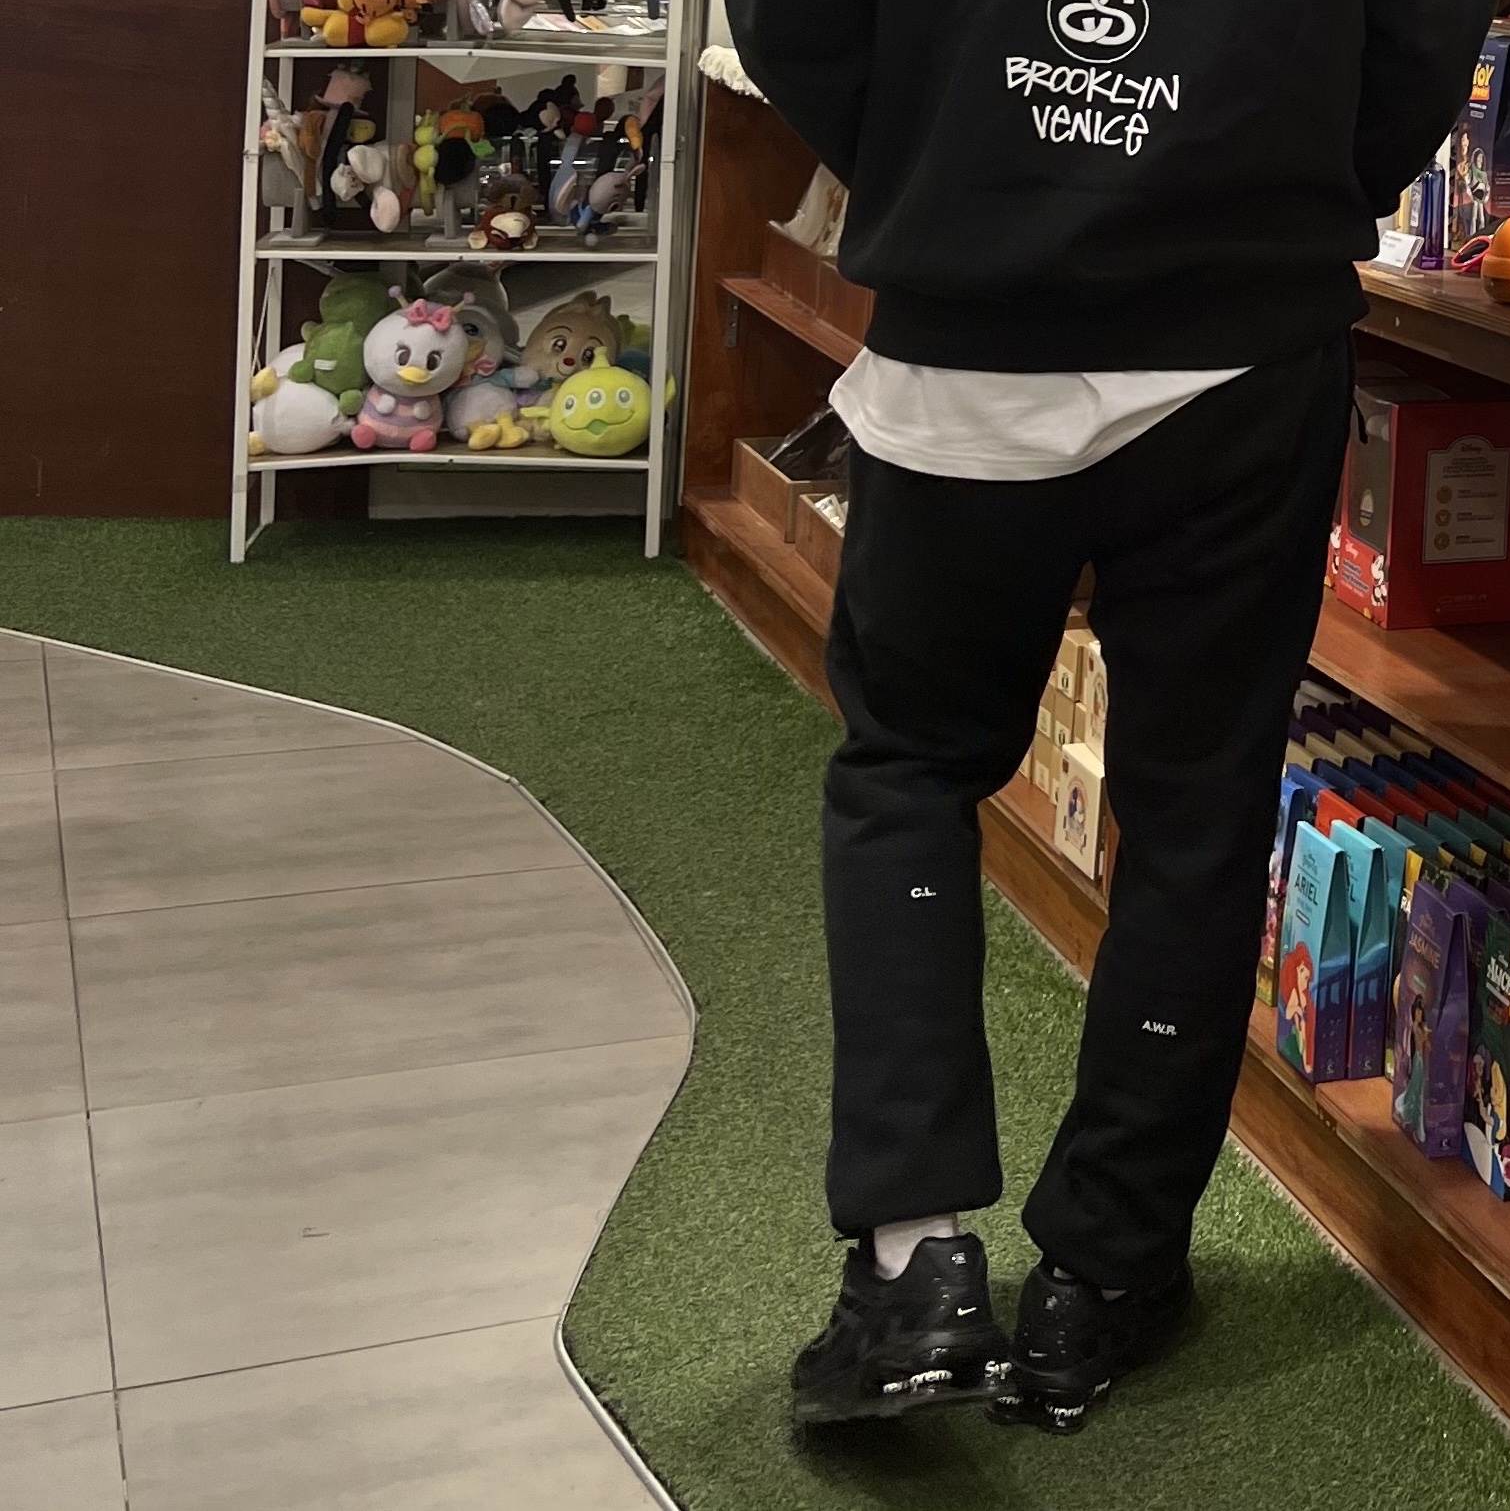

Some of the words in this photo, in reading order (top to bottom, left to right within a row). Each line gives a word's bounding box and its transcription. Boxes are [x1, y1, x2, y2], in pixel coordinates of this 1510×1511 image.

[1006, 56, 1181, 111] BROOKLYN
[910, 886, 937, 899] C.L.
[1294, 873, 1319, 906] ARIEL
[1408, 933, 1441, 969] JASMINE
[1142, 1020, 1178, 1036] A.W.R.
